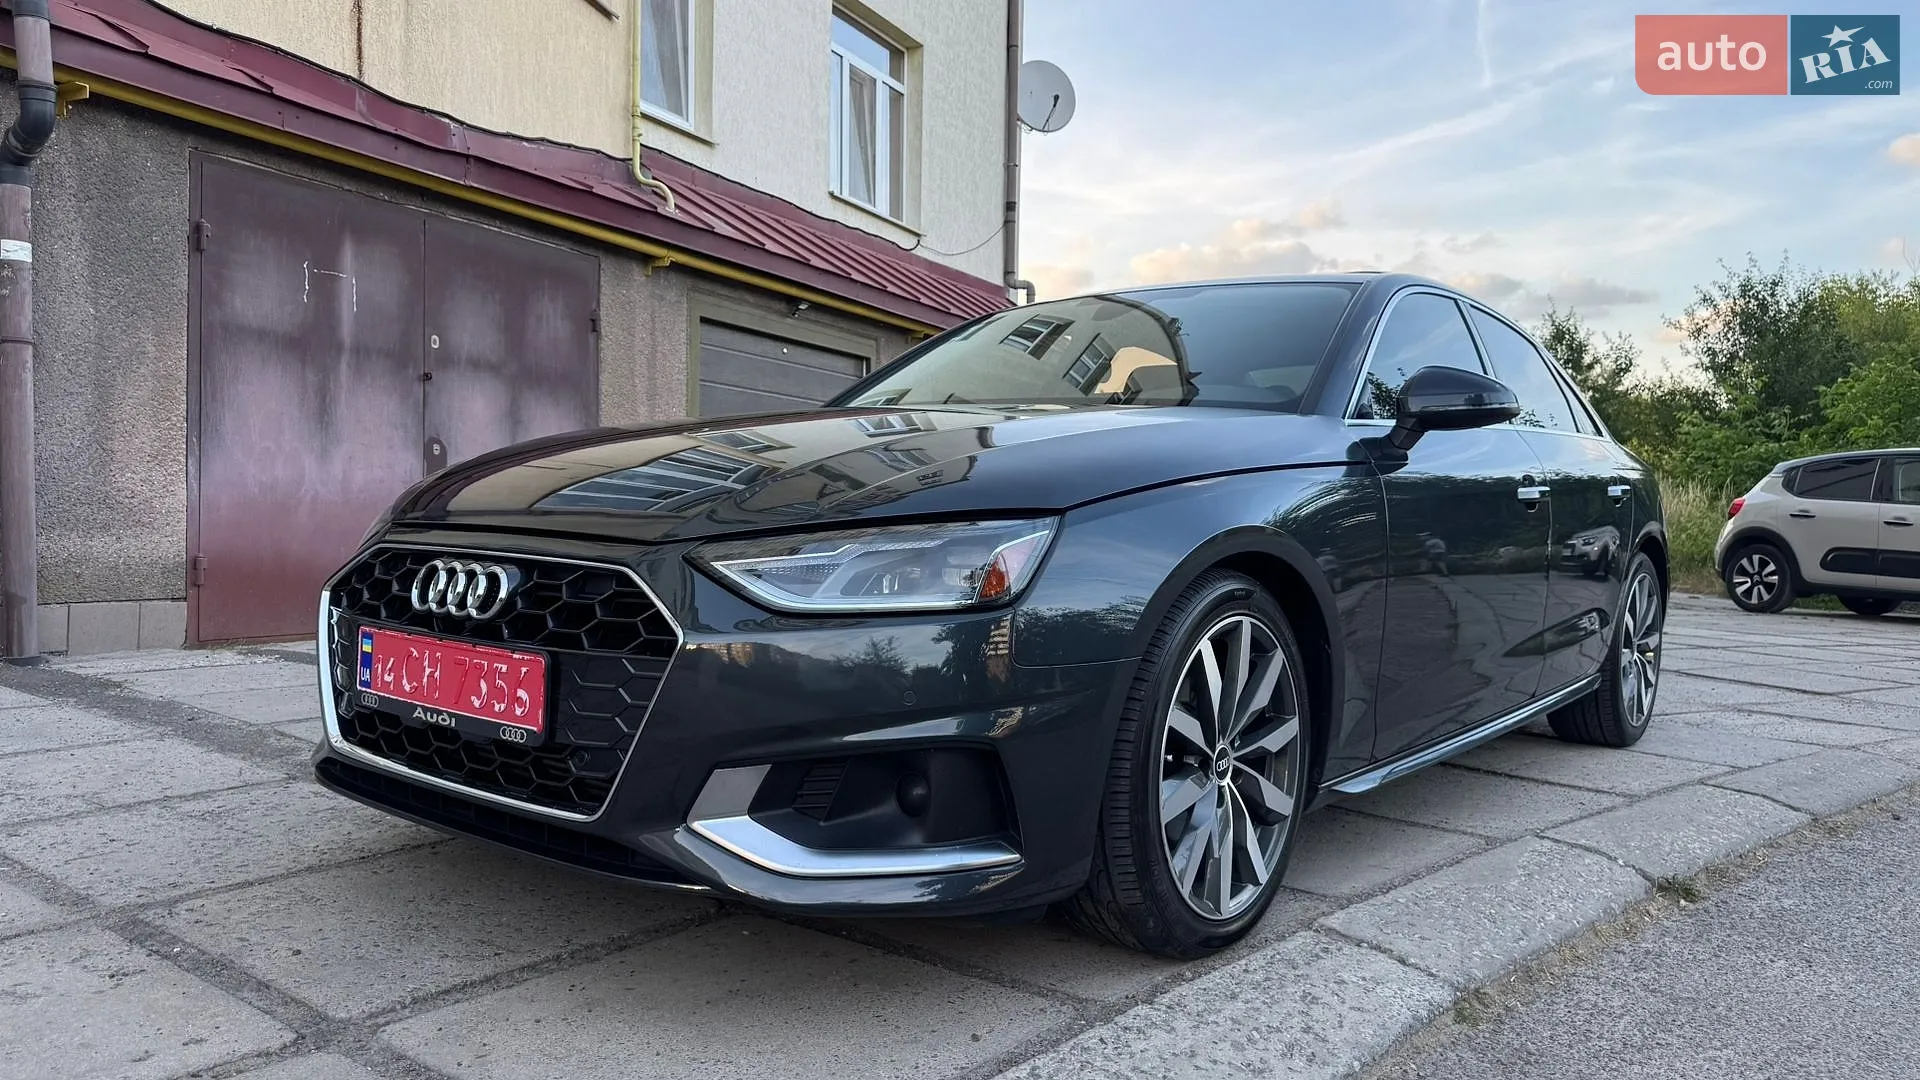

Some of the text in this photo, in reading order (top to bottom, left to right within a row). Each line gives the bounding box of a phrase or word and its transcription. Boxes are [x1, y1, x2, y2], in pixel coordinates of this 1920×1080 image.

[361, 666, 371, 683] UA
[453, 655, 530, 717] 7356
[412, 706, 456, 728] Audi
